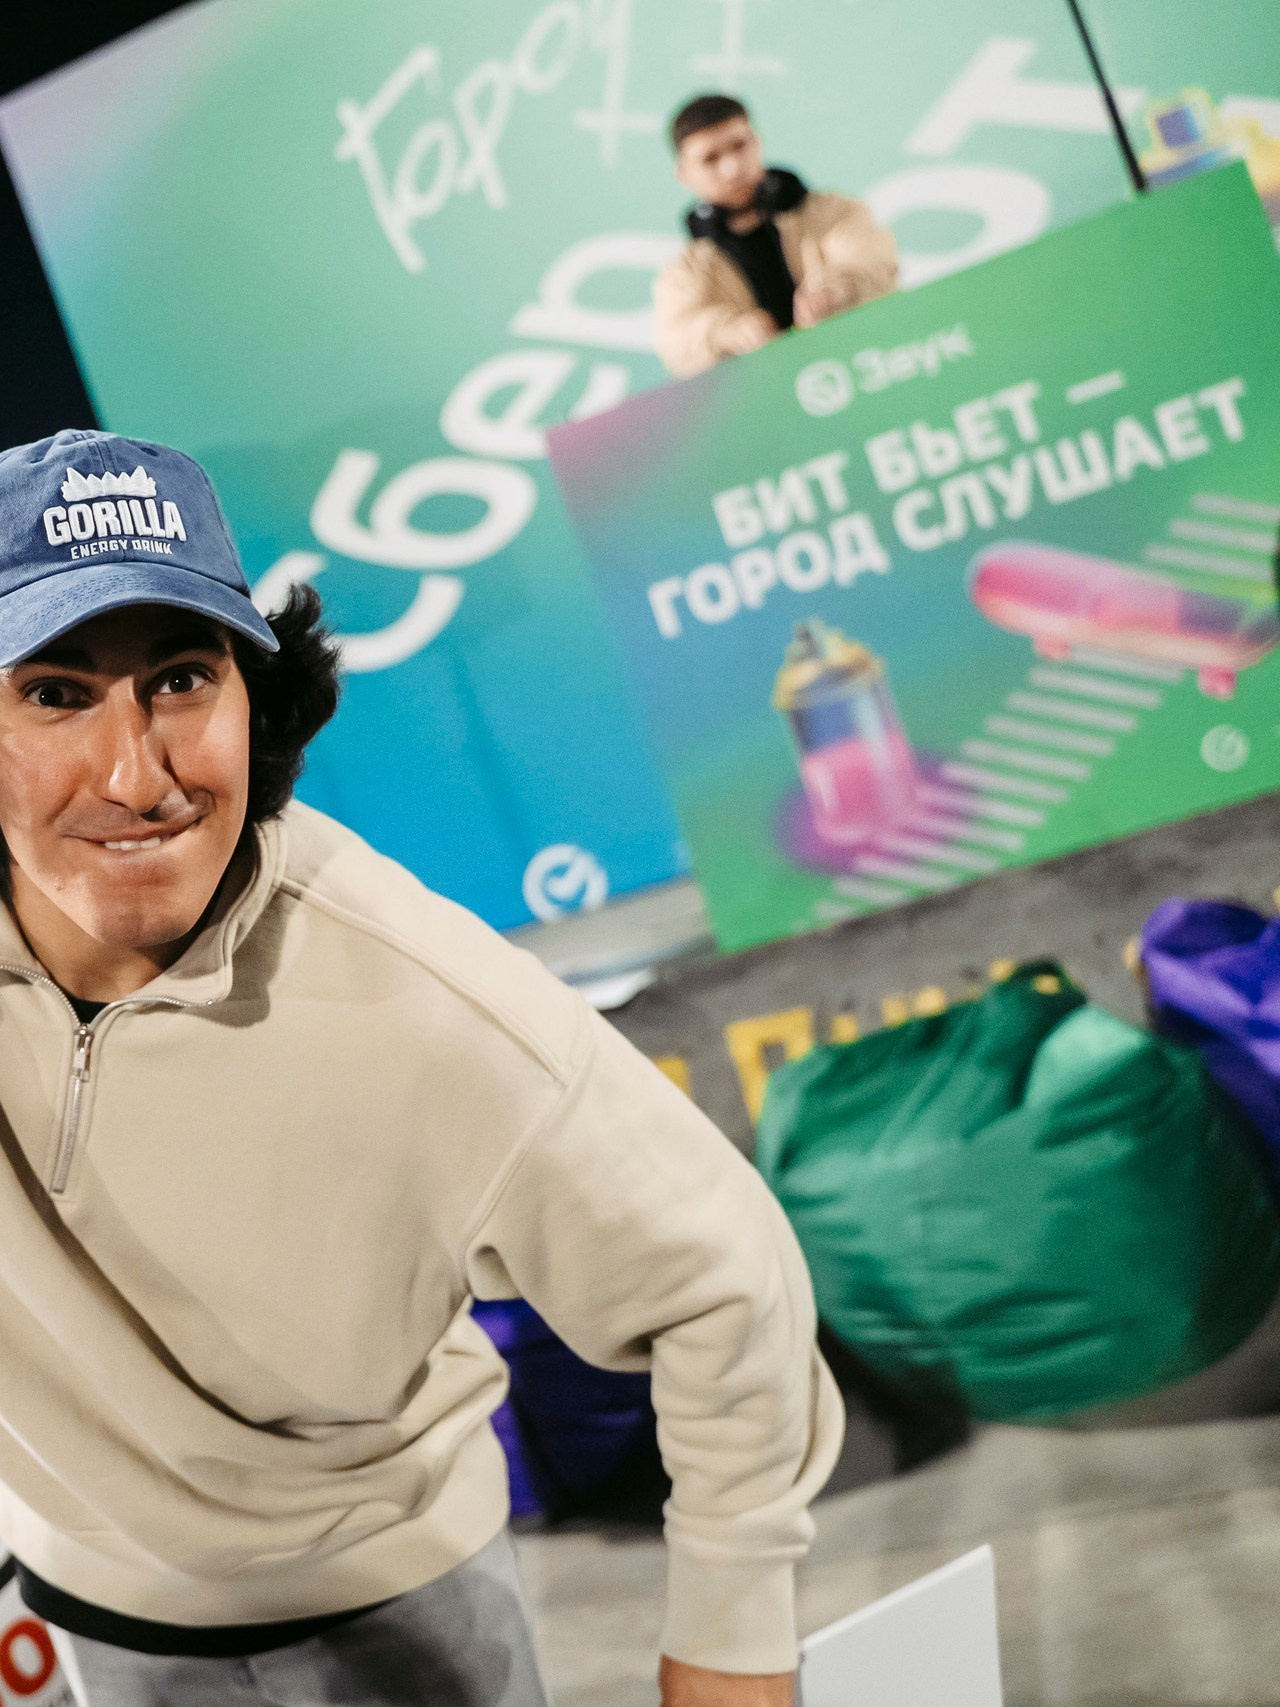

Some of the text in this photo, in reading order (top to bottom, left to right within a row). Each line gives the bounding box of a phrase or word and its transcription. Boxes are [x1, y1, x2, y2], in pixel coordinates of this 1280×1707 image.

[647, 376, 1247, 640] ГОРОД СЛУШАЕТ
[712, 449, 851, 549] БИТ
[864, 377, 1043, 494] БЬЕТ
[43, 499, 187, 546] GORILLA
[70, 539, 173, 560] ENERGY DRINK
